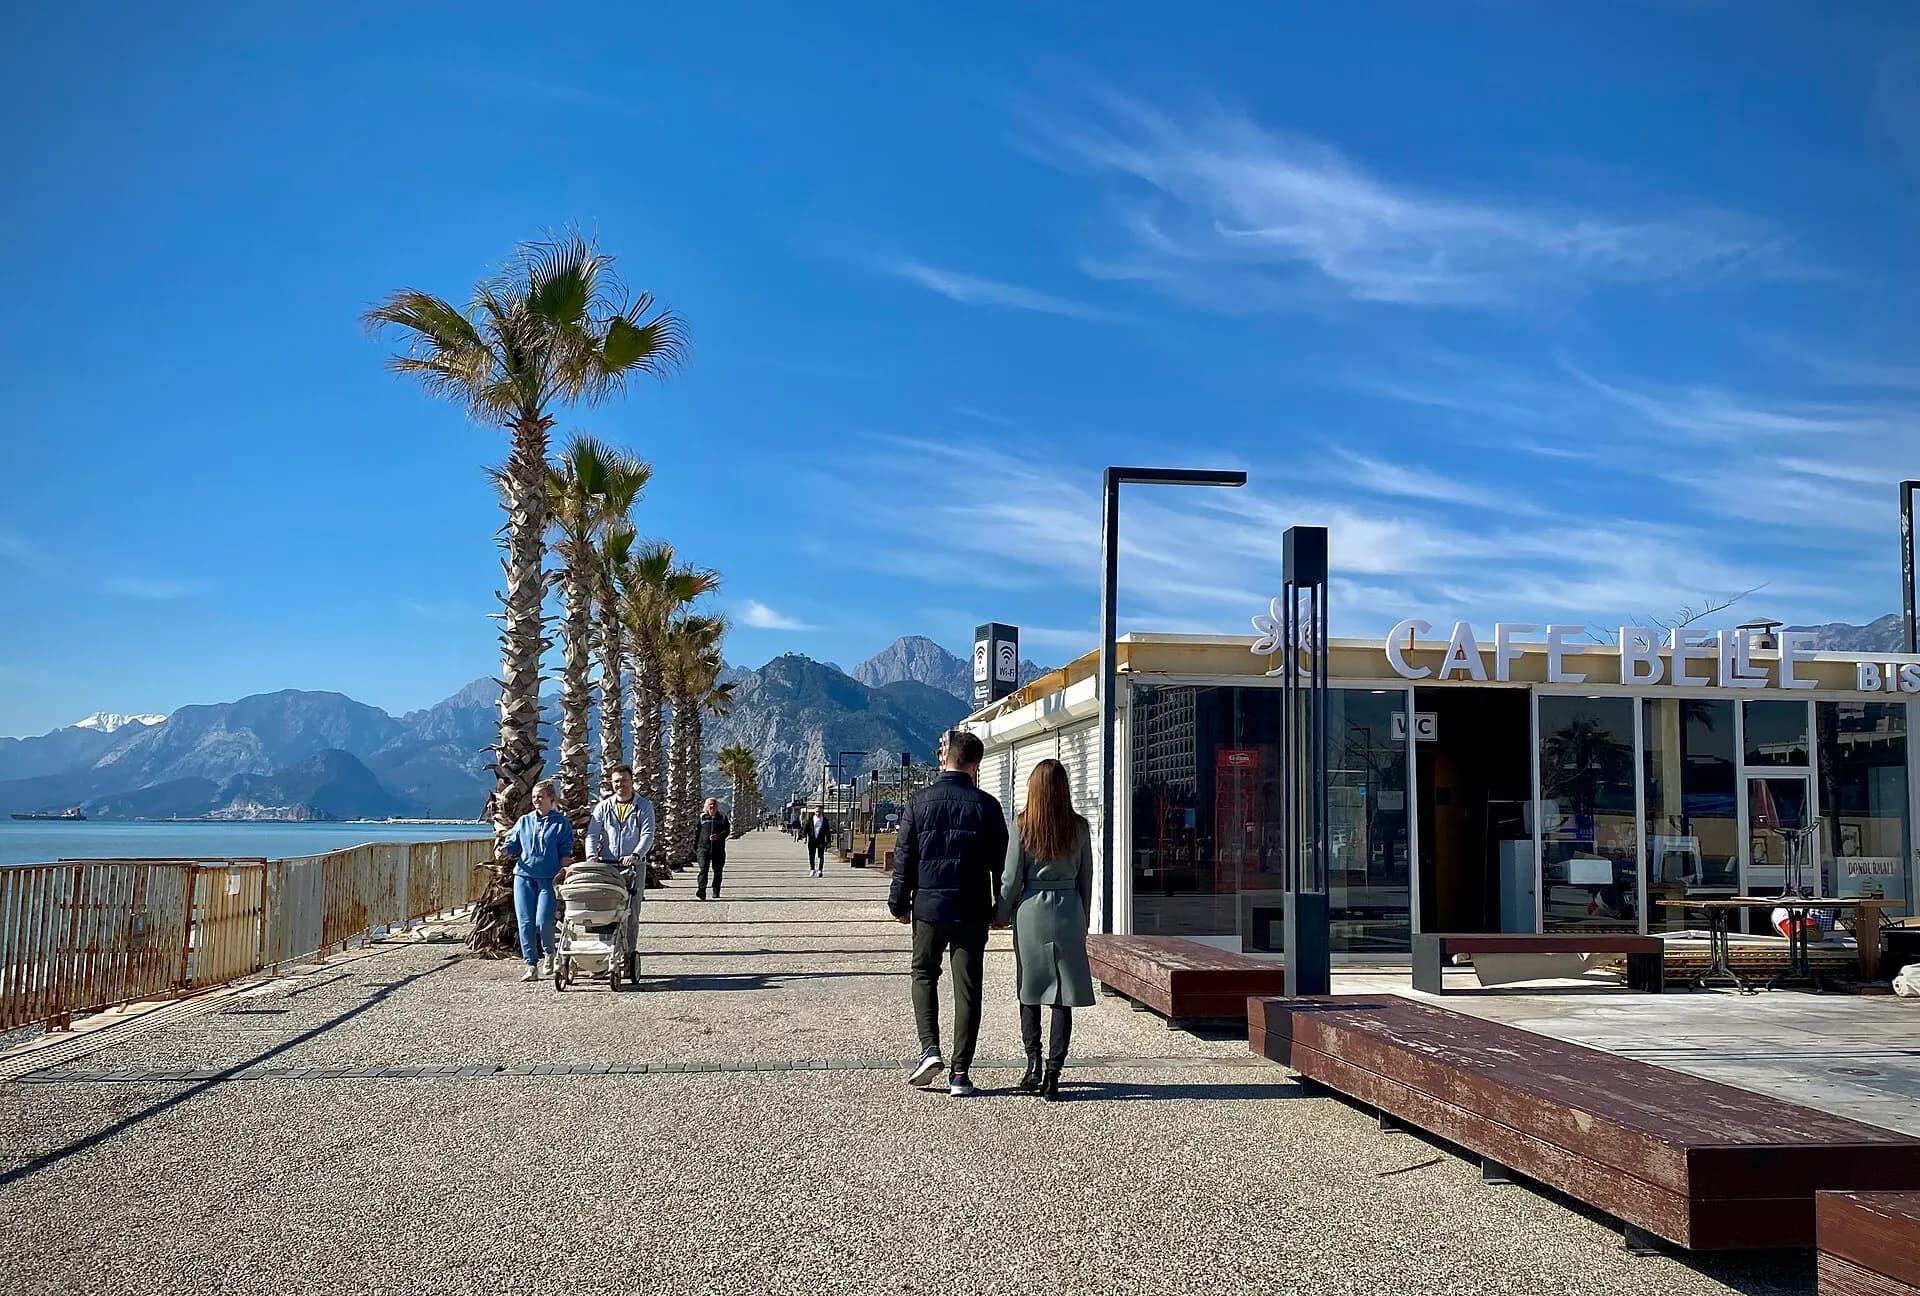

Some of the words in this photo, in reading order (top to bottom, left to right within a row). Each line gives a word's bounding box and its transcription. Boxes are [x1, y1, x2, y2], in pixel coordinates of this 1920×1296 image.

[999, 667, 1015, 677] Wi-Fi
[1386, 618, 1587, 683] CAFE
[1619, 626, 1820, 689] BELLE
[1856, 662, 1920, 693] BIS
